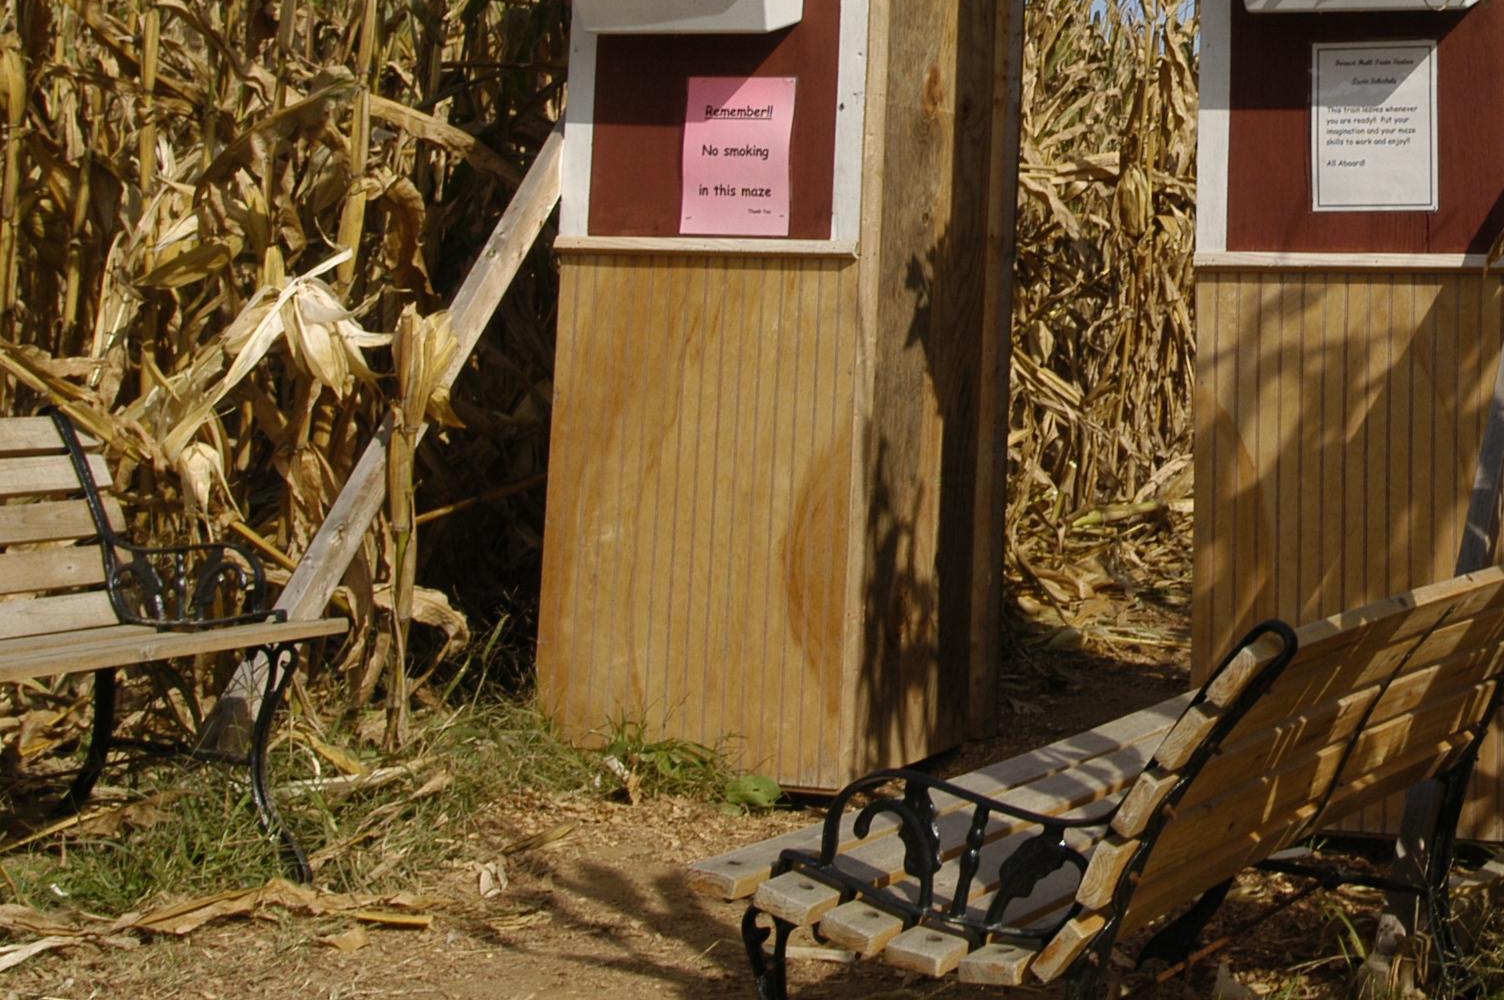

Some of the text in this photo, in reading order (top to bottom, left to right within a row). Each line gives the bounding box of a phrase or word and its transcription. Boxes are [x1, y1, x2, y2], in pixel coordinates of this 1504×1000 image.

[705, 104, 773, 119] Remember!!
[1385, 105, 1418, 113] whenever
[1326, 118, 1338, 126] you
[1380, 115, 1392, 124] Put
[1394, 117, 1410, 125] your
[1326, 128, 1365, 136] imagination
[1367, 127, 1379, 135] and
[1381, 128, 1396, 136] your
[1326, 138, 1344, 146] skills
[1346, 138, 1354, 146] to
[1355, 138, 1372, 146] work
[702, 144, 769, 161] No smoking
[1326, 159, 1336, 167] All
[698, 184, 772, 198] in this maze
